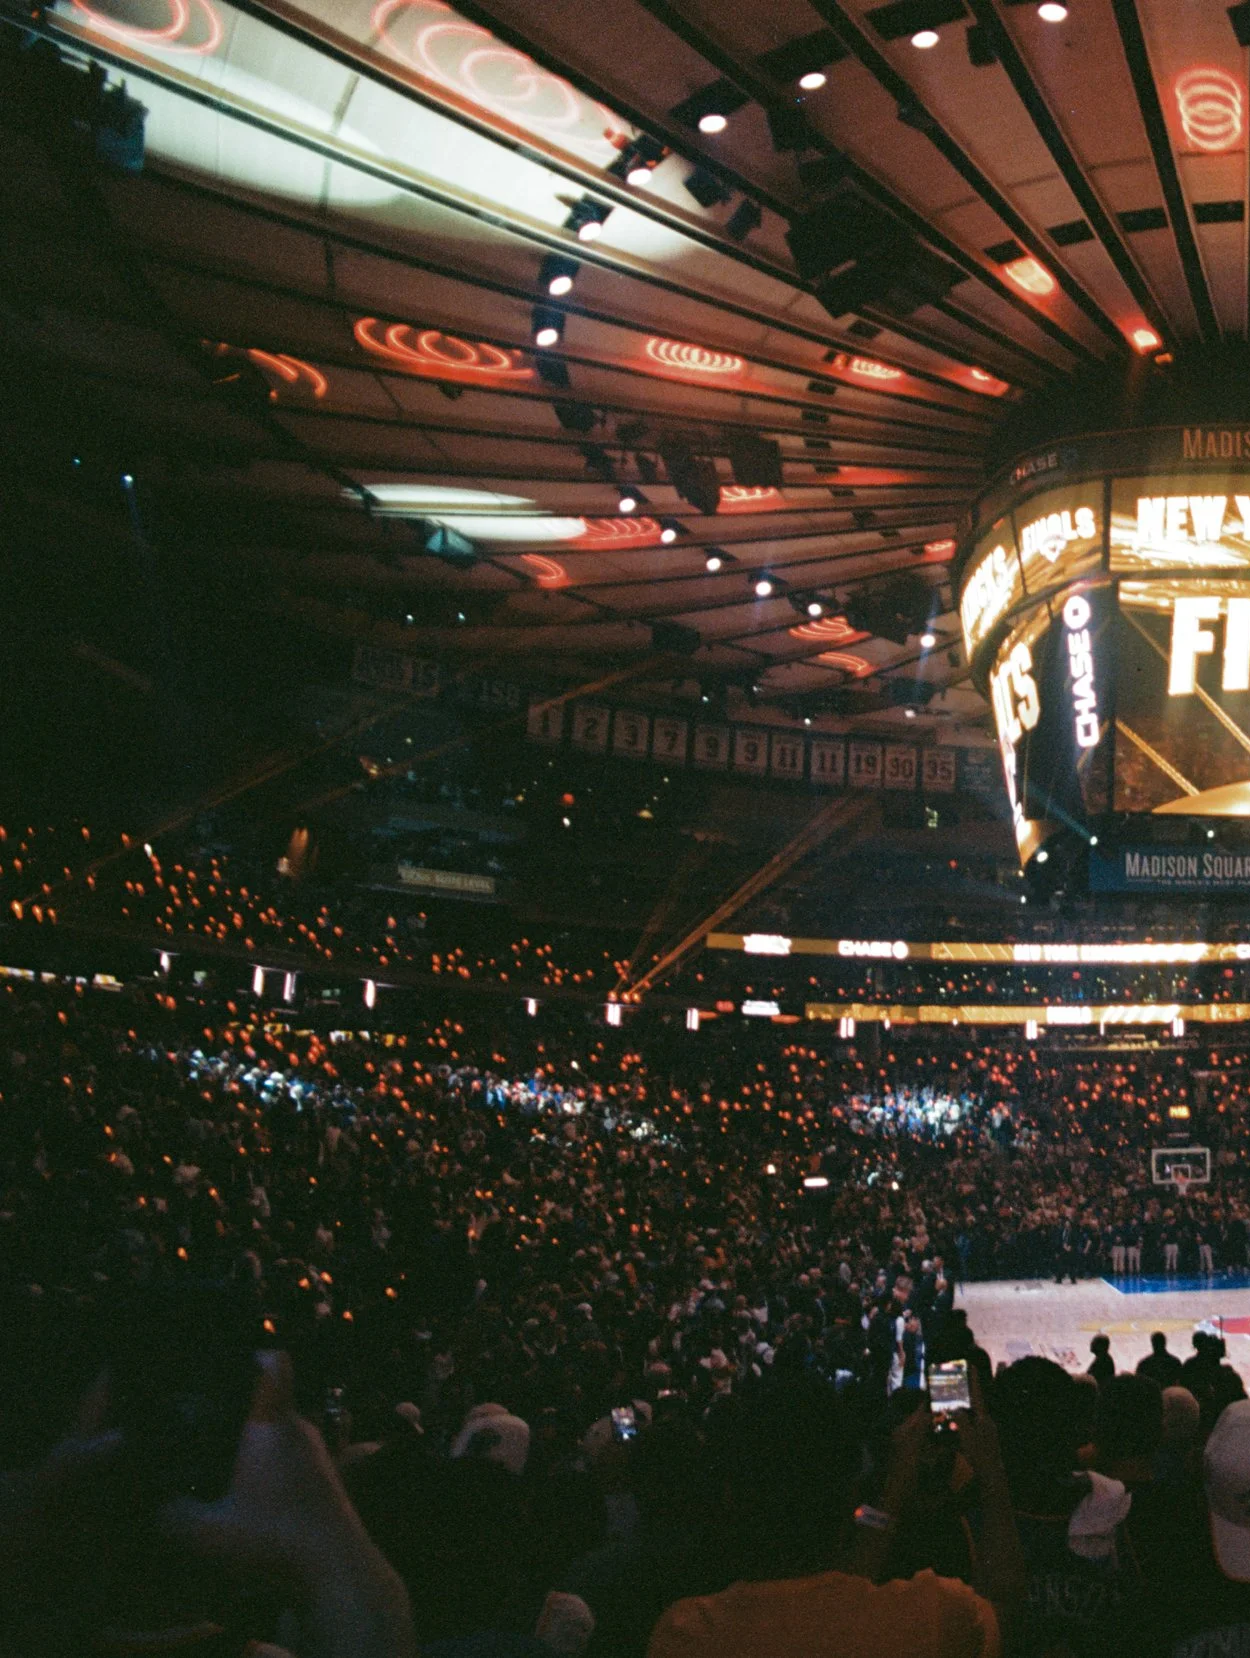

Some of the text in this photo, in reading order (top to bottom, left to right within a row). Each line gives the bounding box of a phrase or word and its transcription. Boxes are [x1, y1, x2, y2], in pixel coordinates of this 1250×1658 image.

[1137, 495, 1227, 543] NEW
[1067, 629, 1100, 748] CHASE
[584, 717, 598, 740] 2
[625, 723, 639, 747] 3
[664, 729, 678, 752] 7
[744, 741, 758, 763] 9
[777, 745, 798, 770] 11
[818, 749, 839, 774] 11
[855, 752, 877, 775] 19
[1124, 851, 1198, 878] MADISON
